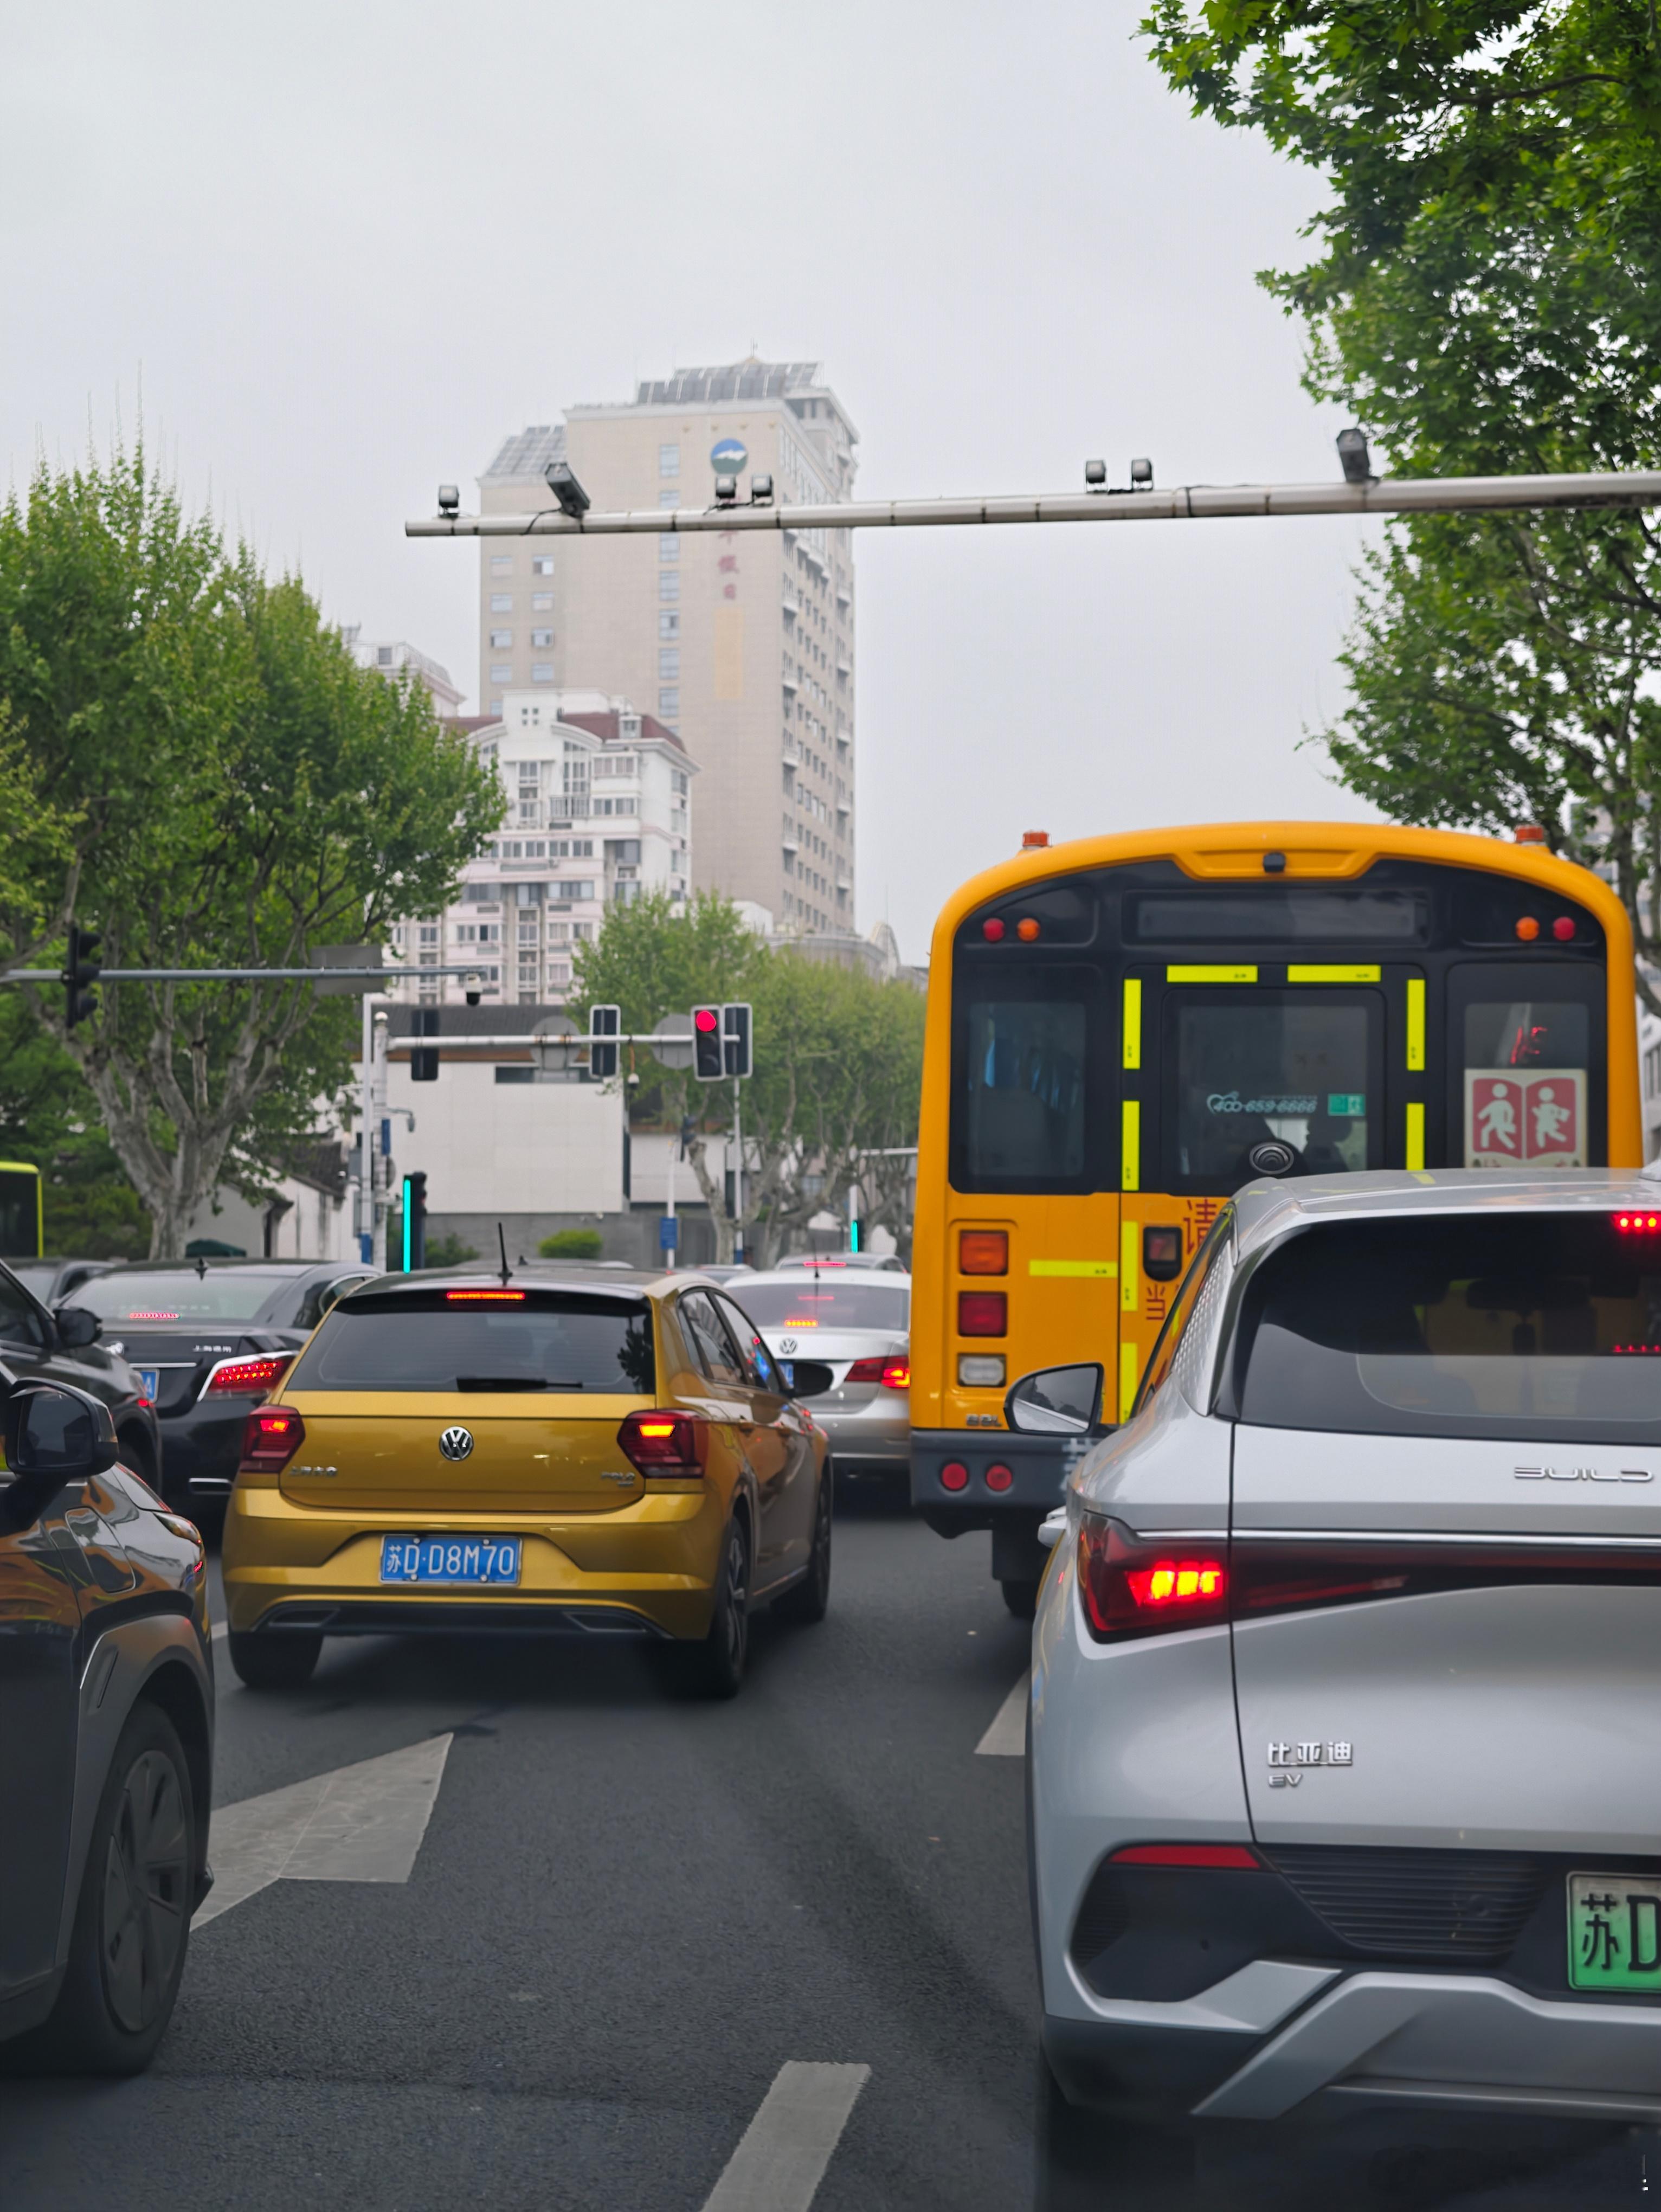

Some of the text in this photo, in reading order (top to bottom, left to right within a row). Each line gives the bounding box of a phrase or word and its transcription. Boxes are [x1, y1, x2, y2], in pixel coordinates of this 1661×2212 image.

[1514, 1467, 1653, 1483] BUILD
[1268, 1741, 1353, 1767] 比亚迪
[1268, 1773, 1302, 1789] EV
